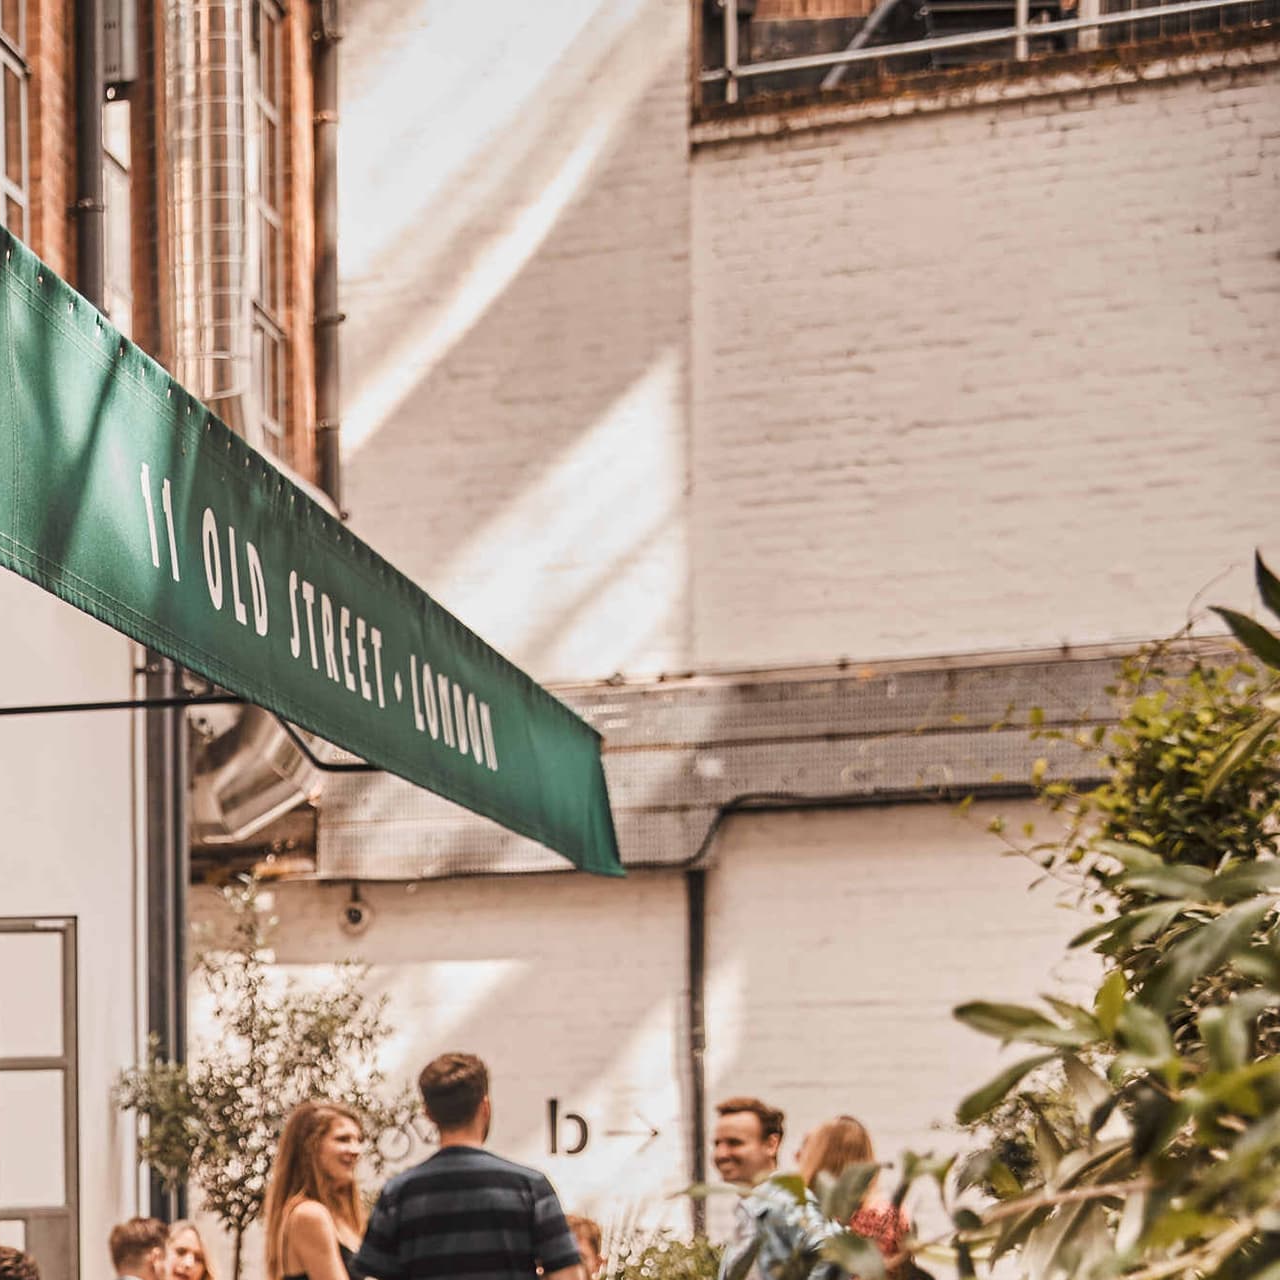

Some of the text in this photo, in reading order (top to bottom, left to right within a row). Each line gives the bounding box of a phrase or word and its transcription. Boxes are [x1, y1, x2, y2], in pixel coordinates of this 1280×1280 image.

[141, 462, 498, 772] 11 OLD STREET LONDON
[548, 1098, 589, 1154] b
